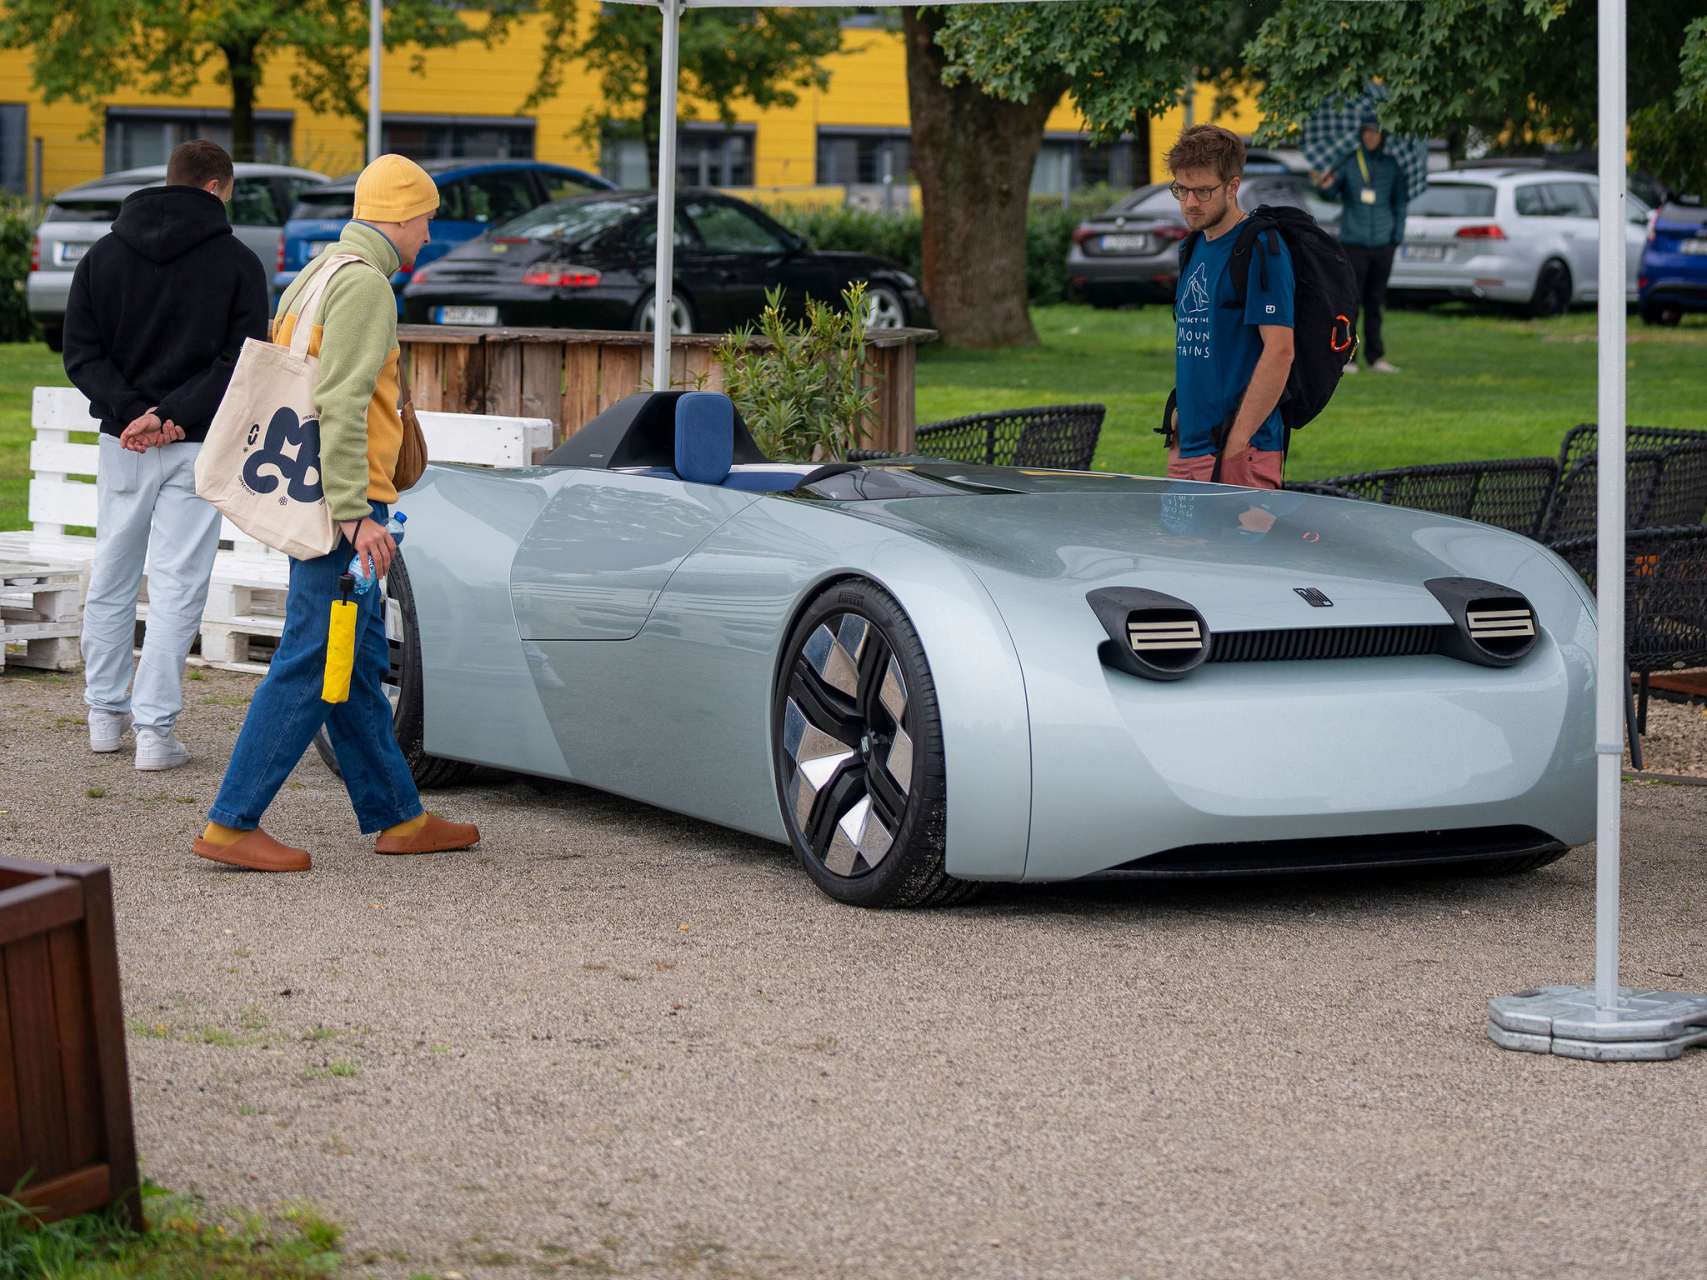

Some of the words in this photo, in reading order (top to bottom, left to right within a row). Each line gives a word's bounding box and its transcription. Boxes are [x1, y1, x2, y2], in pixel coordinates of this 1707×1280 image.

[1177, 327, 1210, 343] MOUN
[1177, 346, 1210, 358] TAINS
[838, 591, 865, 607] PIRELLI
